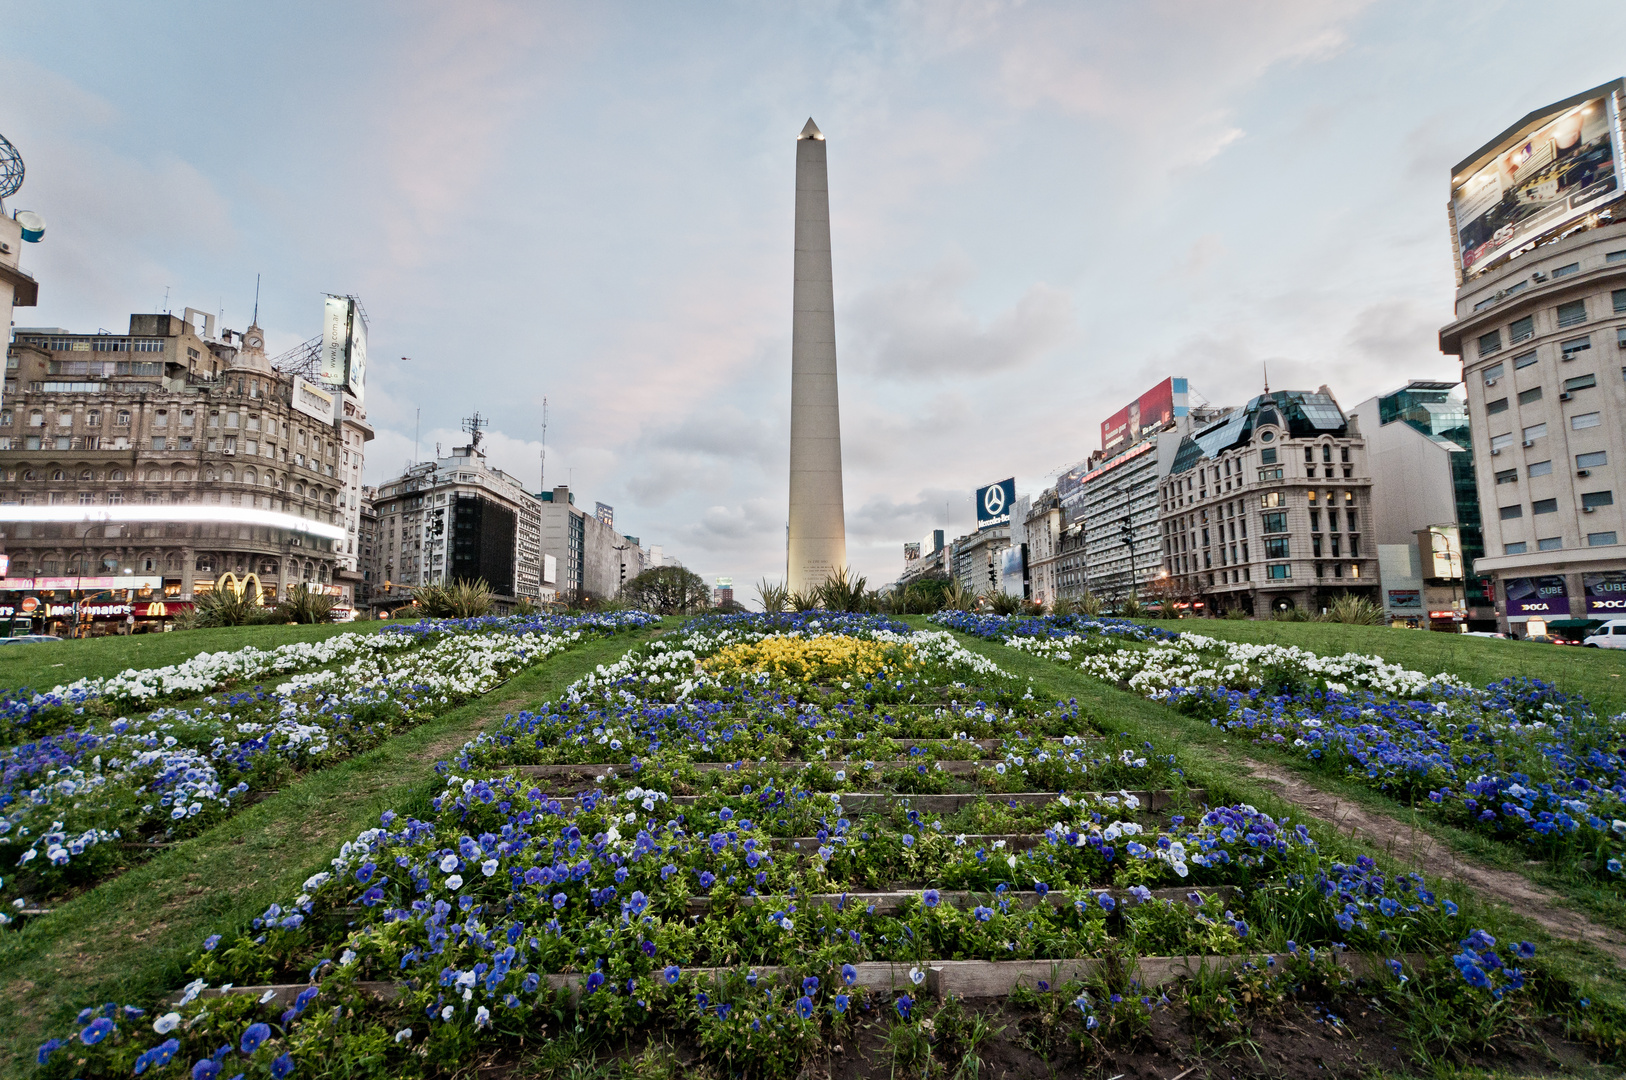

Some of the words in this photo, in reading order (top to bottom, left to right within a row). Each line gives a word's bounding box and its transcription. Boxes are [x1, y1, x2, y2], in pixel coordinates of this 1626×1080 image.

[329, 314, 339, 369] www.lg.com.ar
[978, 513, 1010, 529] Mercedes-Be
[1540, 585, 1563, 595] SUBE
[1529, 602, 1550, 611] OCA
[1605, 600, 1626, 608] OC
